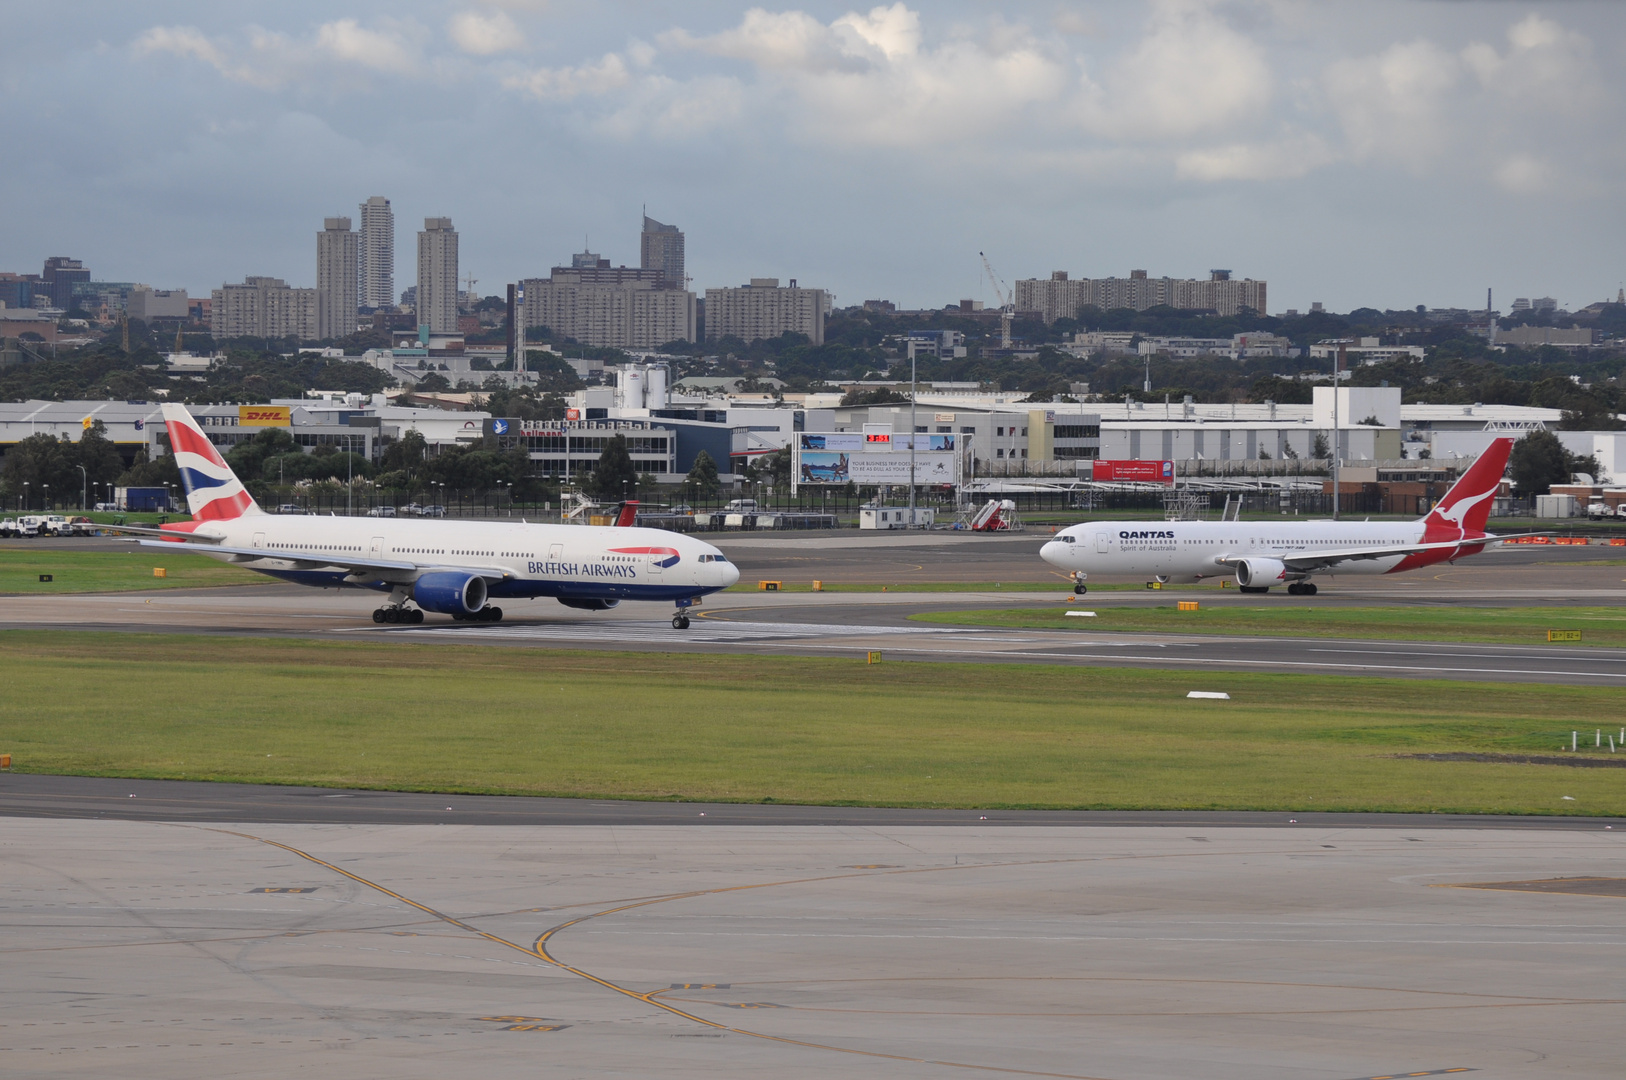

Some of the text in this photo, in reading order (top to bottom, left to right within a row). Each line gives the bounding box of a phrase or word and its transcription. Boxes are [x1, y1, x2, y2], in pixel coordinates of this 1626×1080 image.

[247, 412, 283, 420] DHL
[868, 434, 889, 442] 3:51
[1119, 531, 1175, 539] QANTAS
[528, 562, 636, 578] BRITISH AIRWAYS
